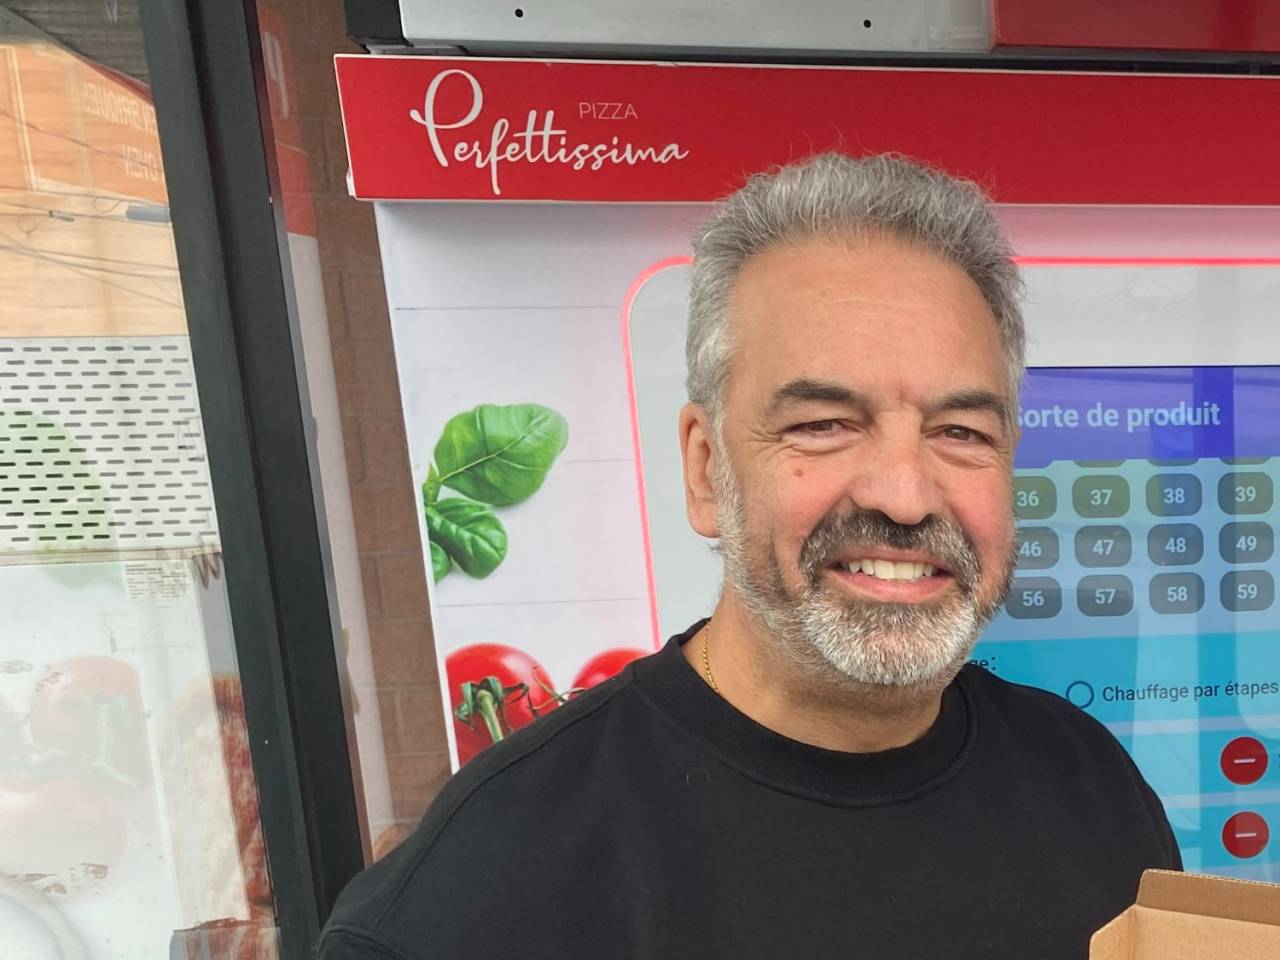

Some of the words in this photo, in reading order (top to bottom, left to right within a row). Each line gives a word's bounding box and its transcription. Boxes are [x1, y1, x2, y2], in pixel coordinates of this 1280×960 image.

[578, 102, 639, 120] PIZZA
[409, 69, 690, 195] Perfettissima
[1086, 402, 1119, 427] de
[1127, 401, 1221, 433] produit
[1017, 490, 1040, 507] 36
[1090, 488, 1113, 506] 37
[1163, 487, 1186, 504] 38
[1235, 485, 1257, 502] 39
[1020, 540, 1042, 558] 46
[1093, 539, 1115, 556] 47
[1165, 537, 1187, 554] 48
[1236, 534, 1258, 552] 49
[1022, 590, 1045, 607] 56
[1095, 587, 1117, 605] 57
[1167, 585, 1189, 602] 58
[1237, 583, 1259, 600] 59
[1102, 683, 1189, 703] Chauffage
[1193, 684, 1219, 699] par
[1225, 681, 1279, 698] étapes
